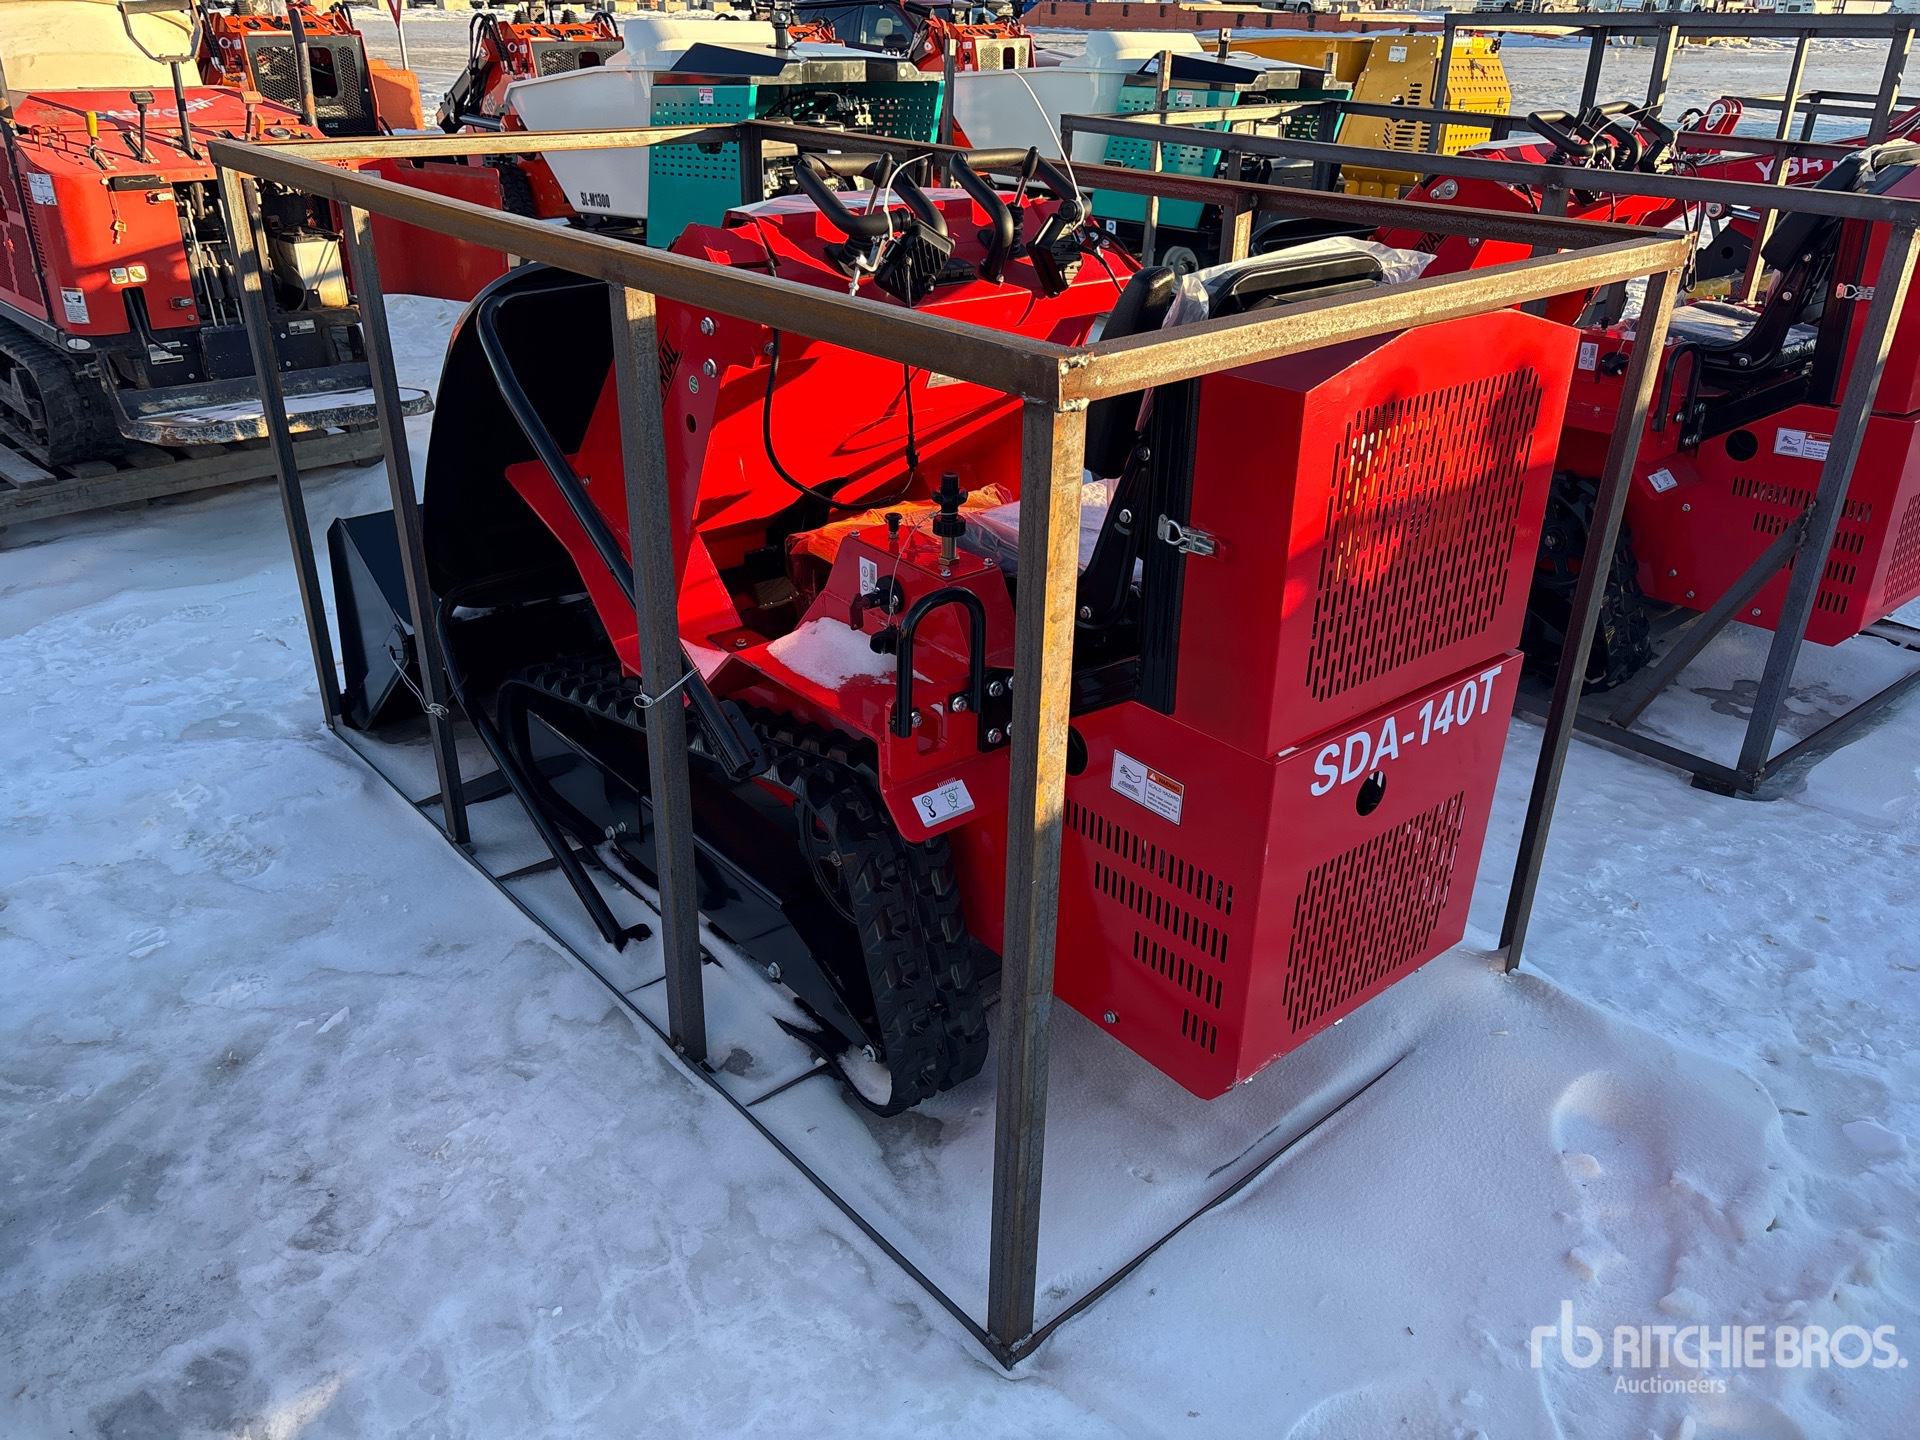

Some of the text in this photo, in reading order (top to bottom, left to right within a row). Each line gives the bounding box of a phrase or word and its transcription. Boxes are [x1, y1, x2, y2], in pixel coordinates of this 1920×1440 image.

[580, 191, 610, 208] SL-M1300
[1310, 665, 1502, 796] SDA-140T
[1148, 782, 1161, 793] SCALD
[1162, 790, 1180, 803] HAZARD
[1158, 777, 1180, 793] WARNING
